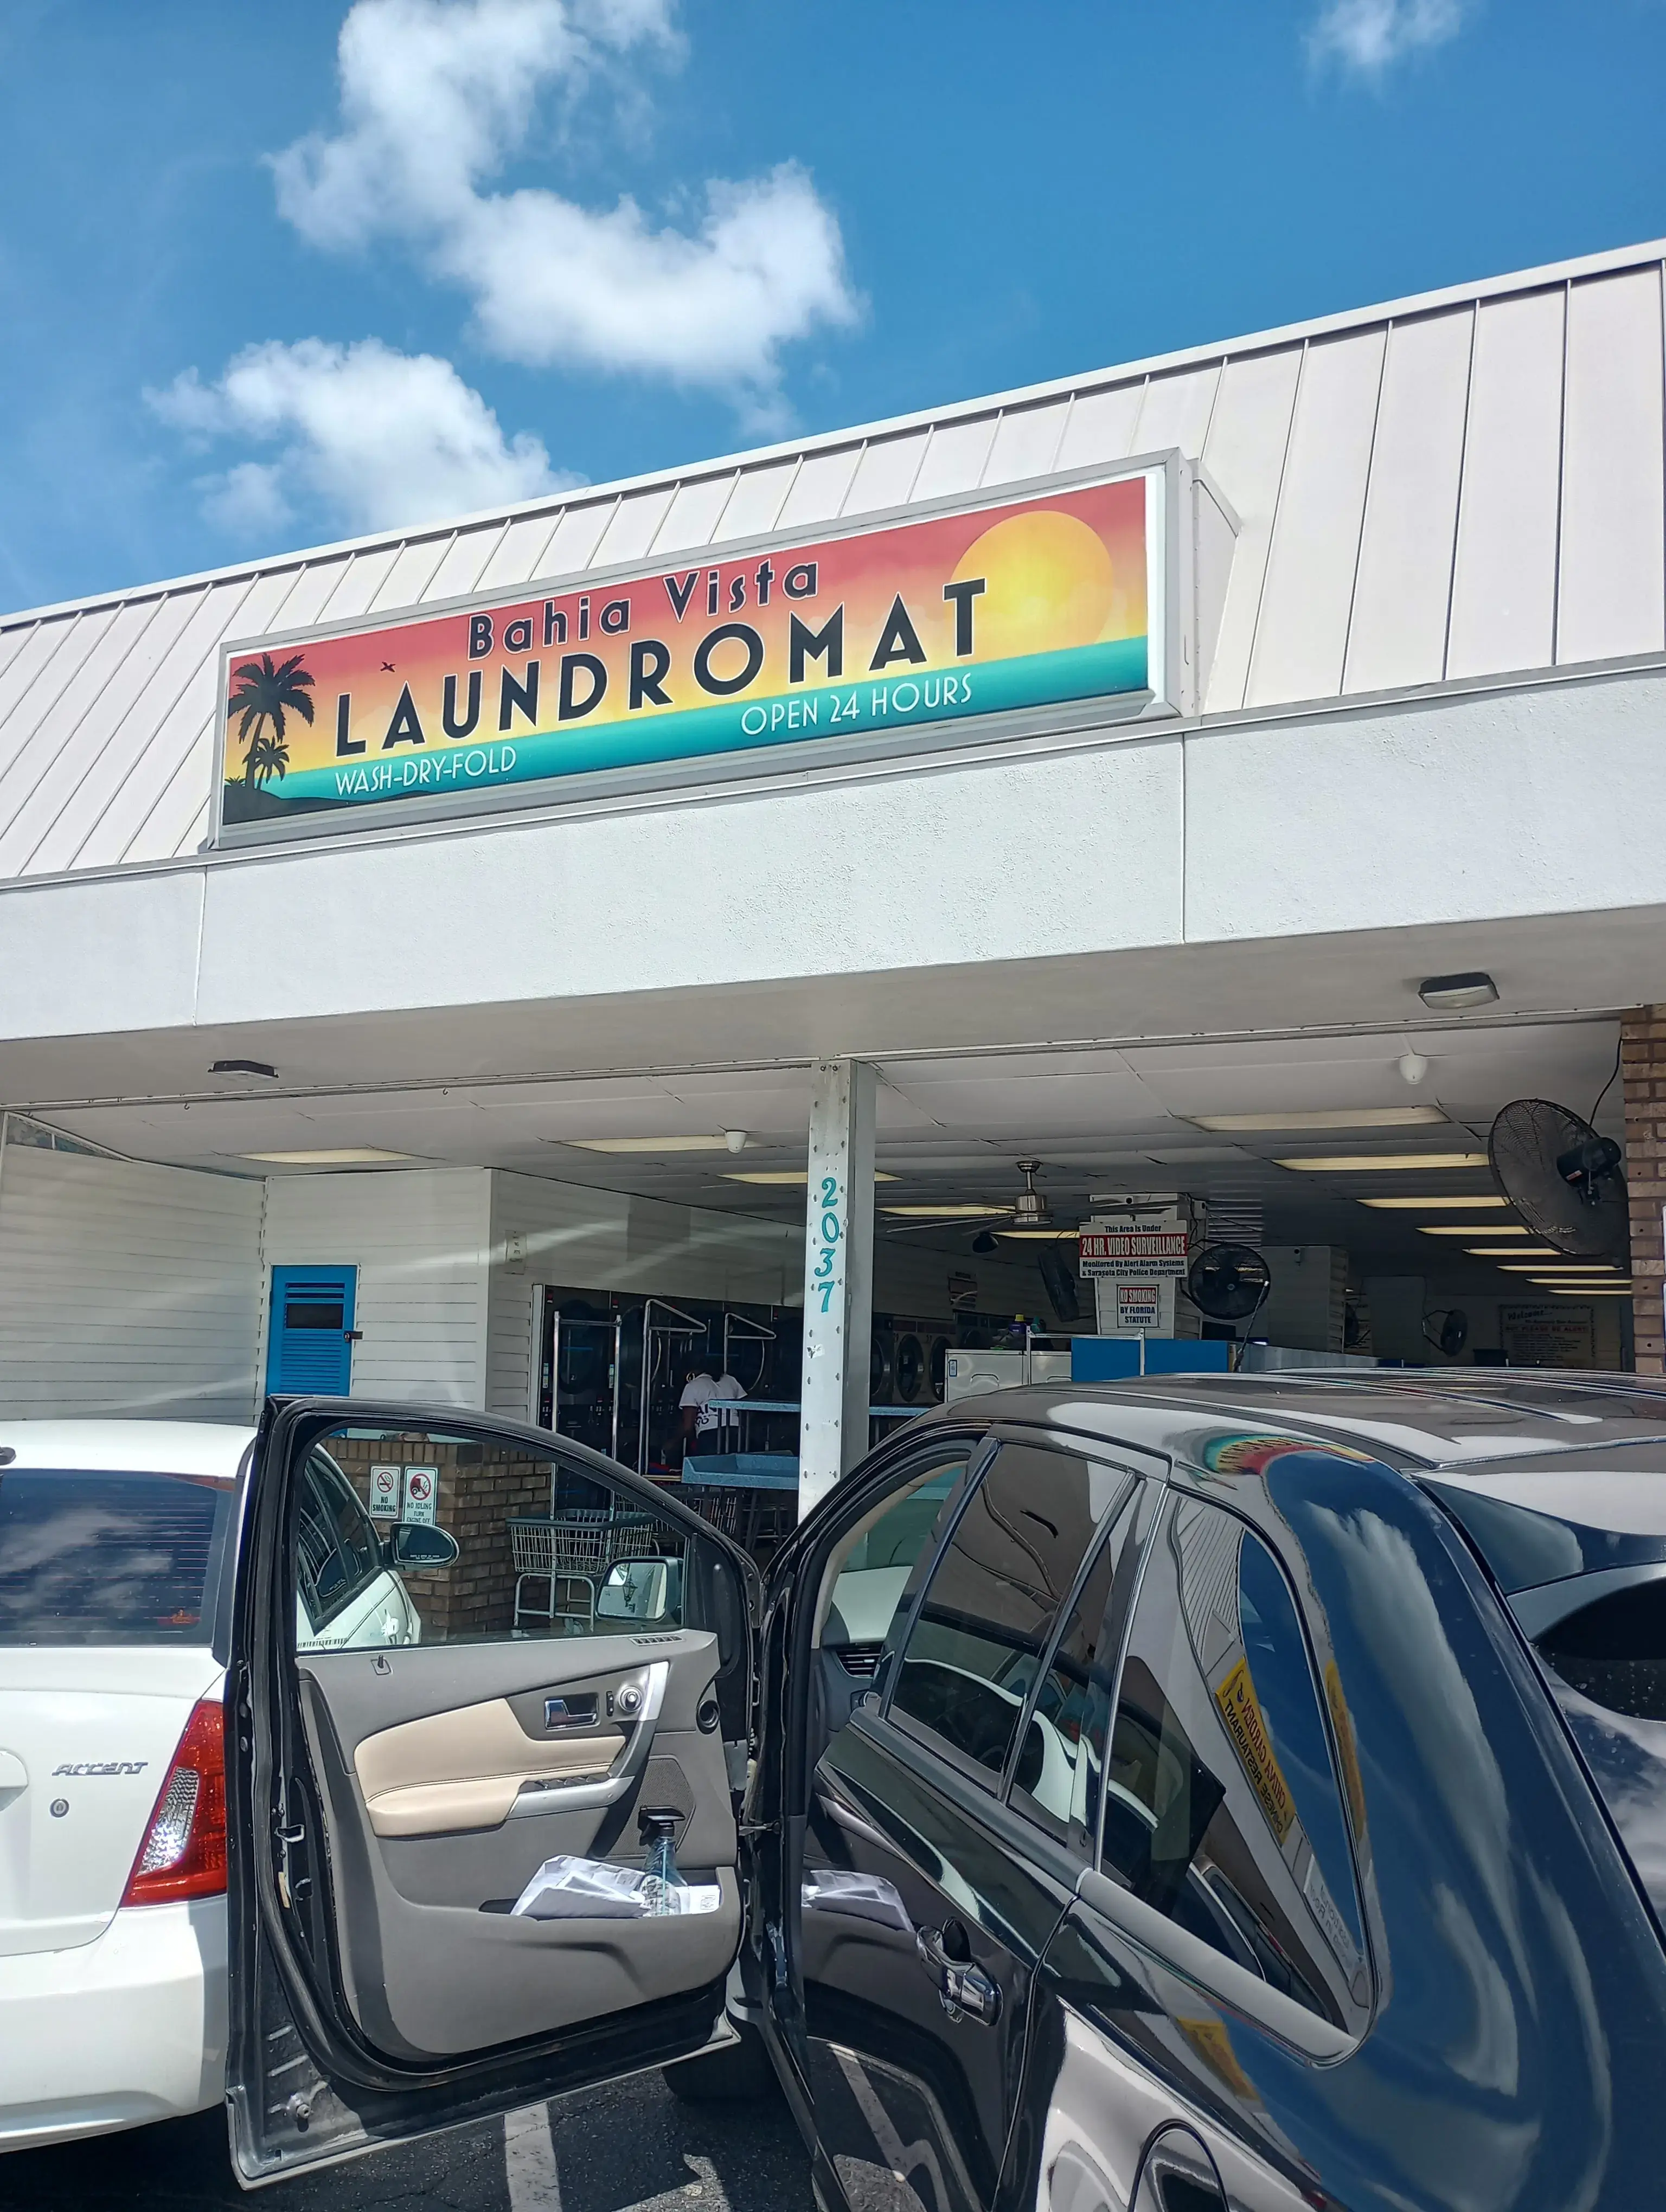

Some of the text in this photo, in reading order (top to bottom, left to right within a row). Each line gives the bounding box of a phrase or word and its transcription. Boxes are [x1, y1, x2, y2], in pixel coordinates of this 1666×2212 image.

[467, 560, 818, 661] Bahia Vista
[335, 578, 986, 757] LAUNDROMAT
[741, 673, 972, 735] OPEN 24 HOURS
[335, 745, 517, 796] WASH-DRY-FOLD
[814, 1176, 840, 1313] 2037
[1082, 1236, 1185, 1256] 24 HR. VIDEO SURVEILLANCE
[1159, 1259, 1184, 1267] Systems
[1087, 1269, 1116, 1277] Sarasota
[1116, 1269, 1129, 1277] City
[1150, 1269, 1185, 1277] Department
[1120, 1289, 1156, 1302] NO SMOKING
[1129, 1306, 1156, 1314] FLORIDA
[373, 1504, 396, 1512] SMOKING
[415, 1502, 432, 1510] IDLING
